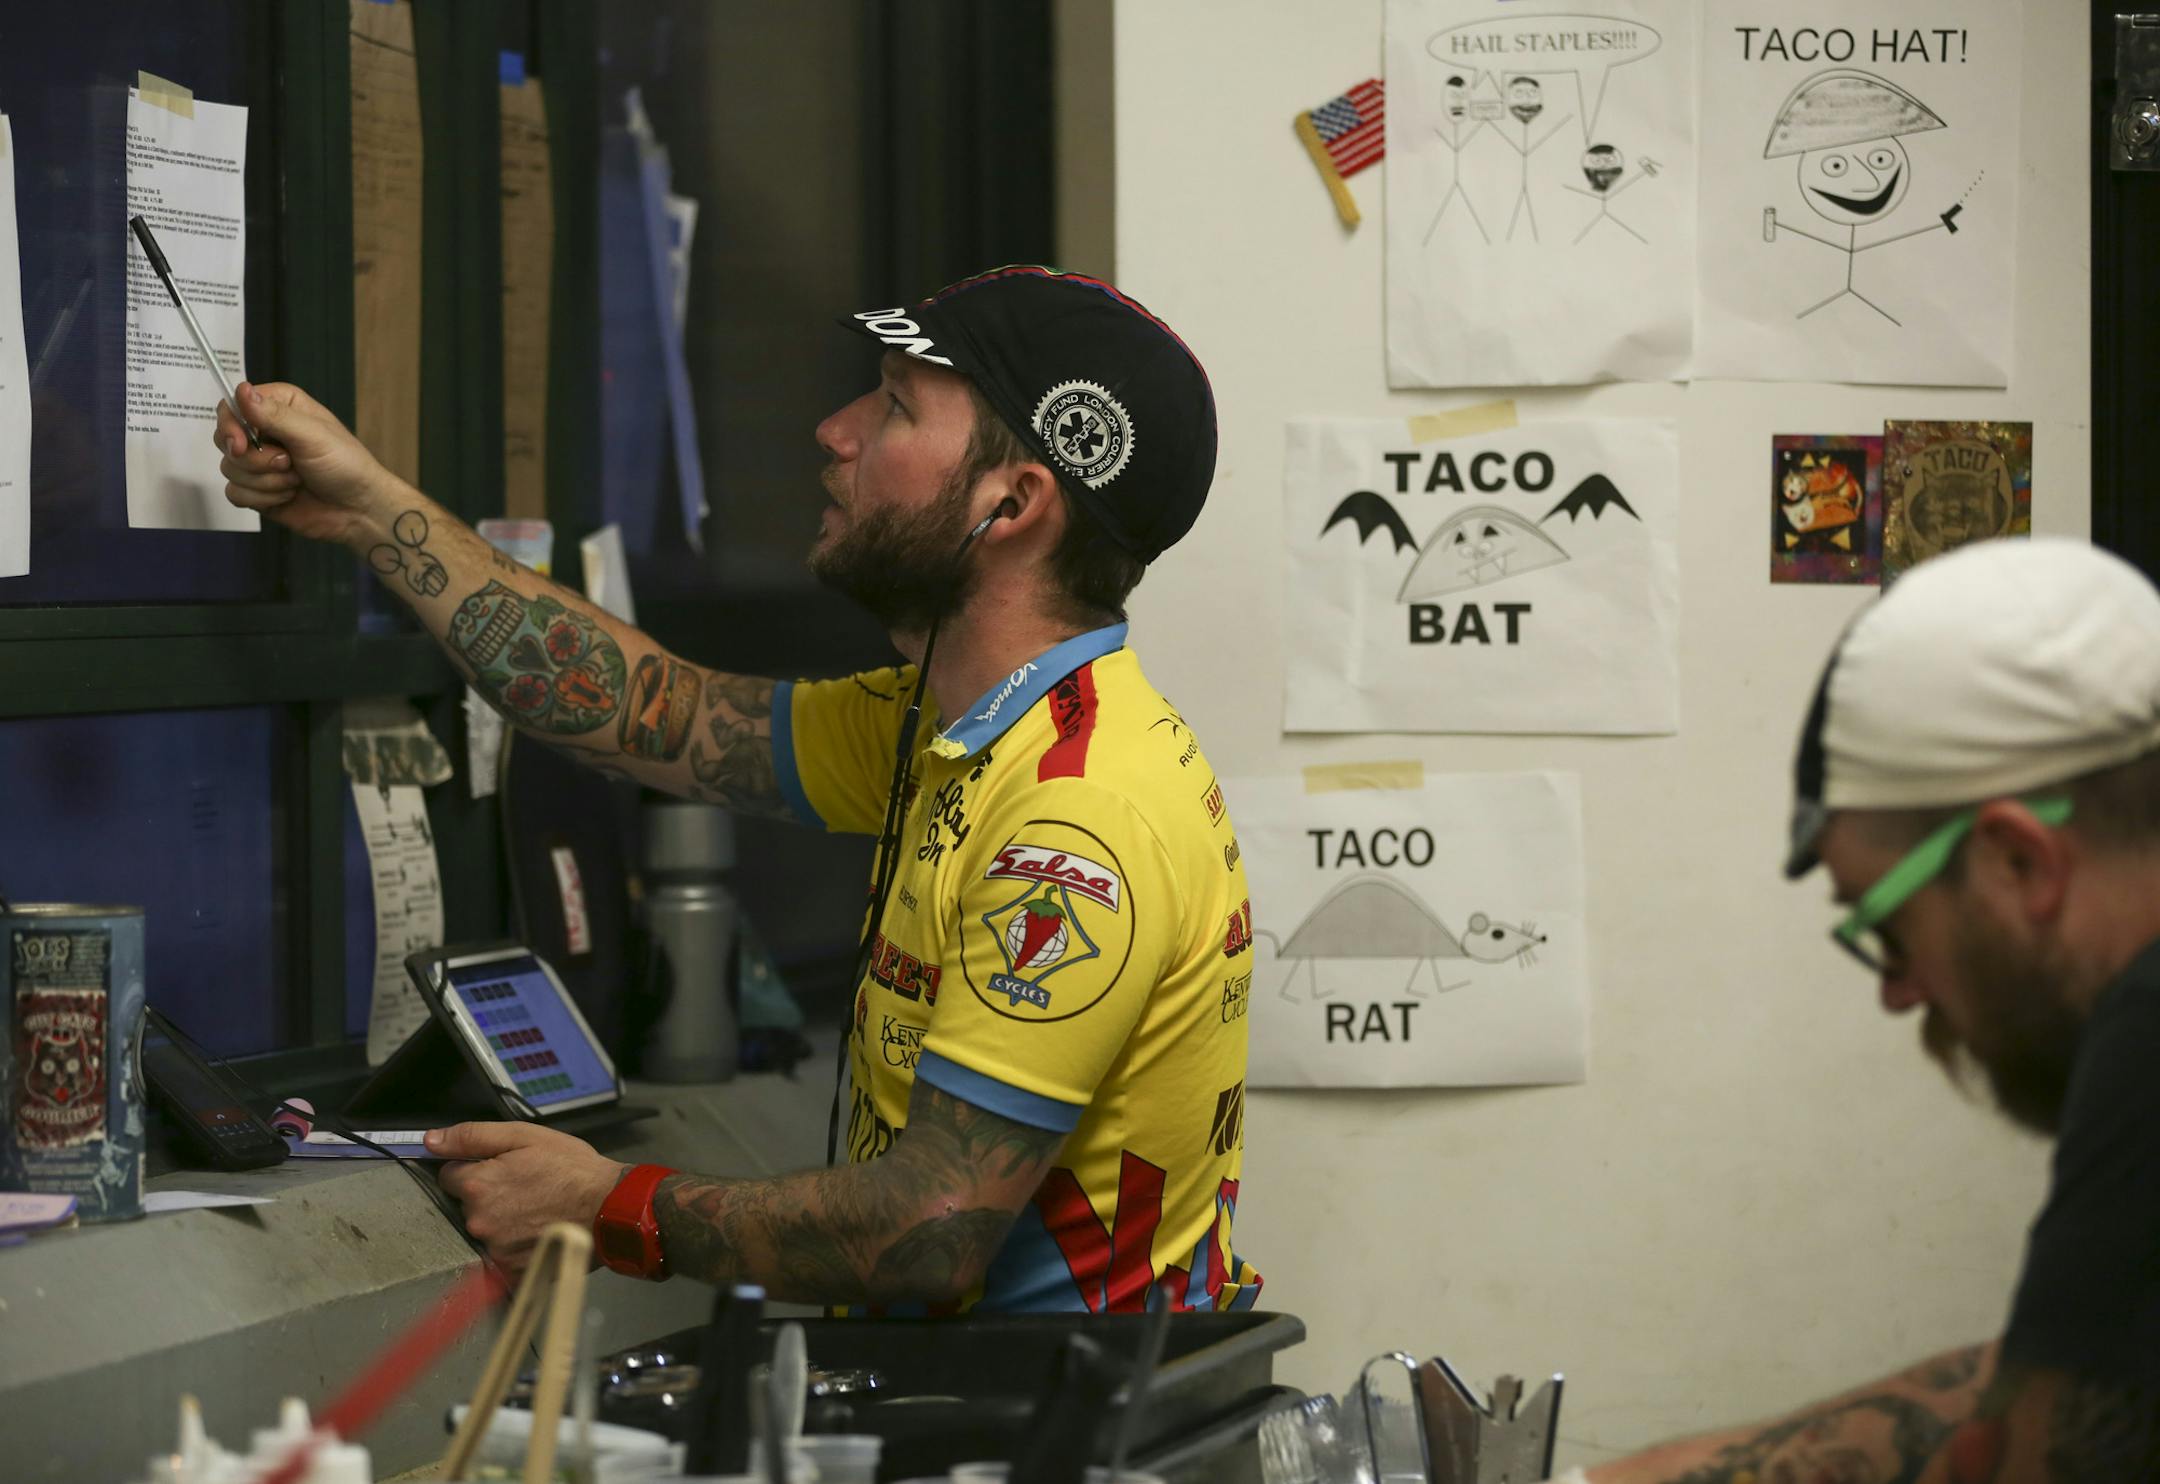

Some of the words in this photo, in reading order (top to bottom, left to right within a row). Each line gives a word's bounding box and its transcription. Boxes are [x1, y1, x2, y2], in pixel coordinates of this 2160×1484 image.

[1451, 33, 1509, 54] HAIL
[1514, 30, 1638, 52] STAPLES!!!!
[1734, 27, 1855, 62] TACO
[1871, 28, 1968, 63] HAT!
[853, 308, 954, 367] DON
[1051, 394, 1079, 415] FUND
[1083, 395, 1120, 432] LONDON
[1086, 435, 1121, 476] COURIER
[1384, 451, 1555, 493] TACO
[1923, 447, 1990, 471] TACO
[1409, 603, 1532, 645] BAT
[1306, 827, 1435, 868] TACO
[990, 848, 1114, 906] Salsa
[994, 977, 1046, 1004] CYCLES
[1325, 1002, 1420, 1043] RAT
